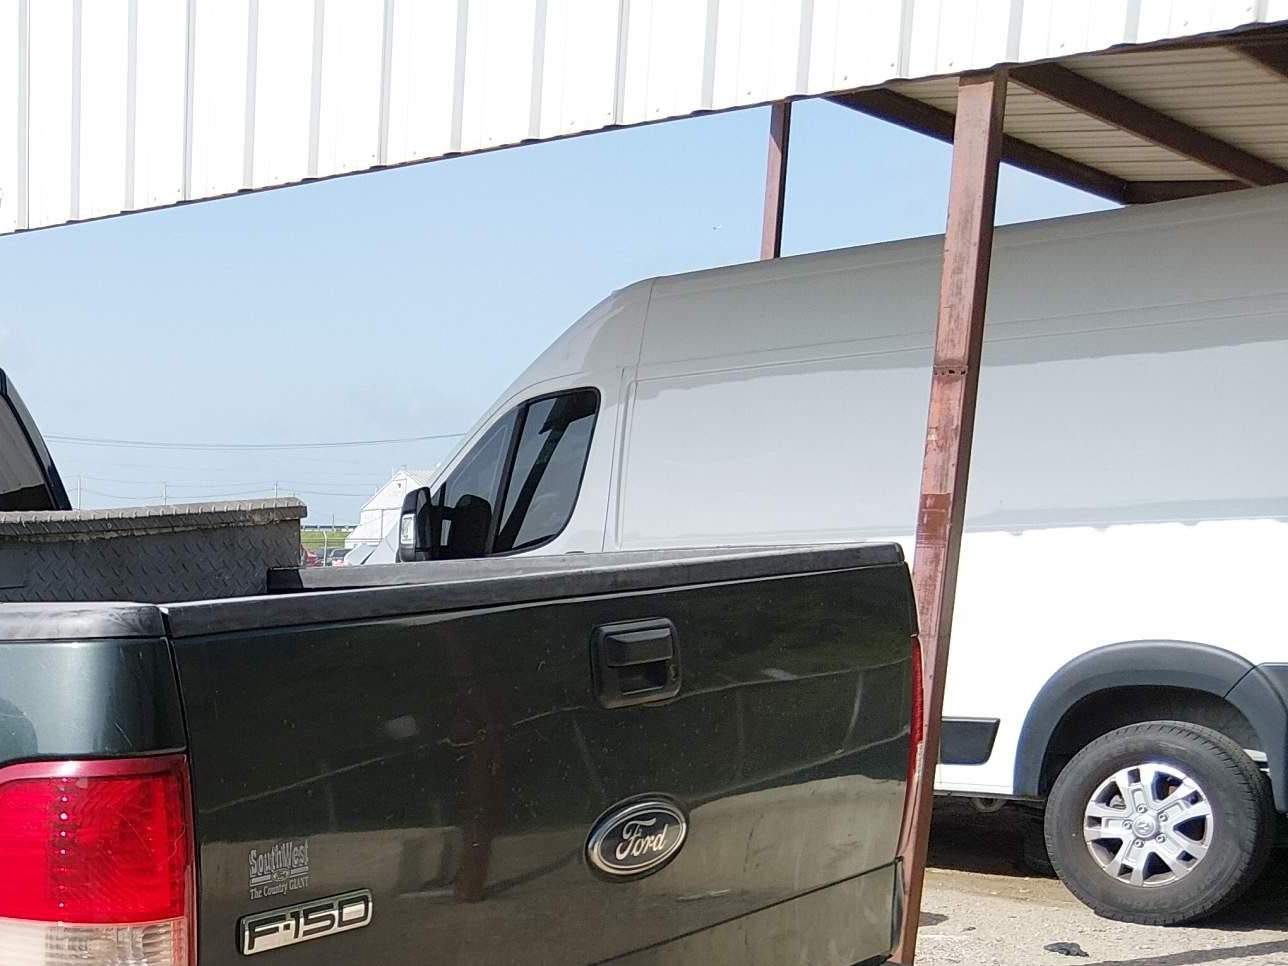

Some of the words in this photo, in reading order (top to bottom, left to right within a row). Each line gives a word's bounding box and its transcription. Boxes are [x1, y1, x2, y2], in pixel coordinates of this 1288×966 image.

[615, 817, 668, 860] Ford
[249, 887, 263, 900] The
[263, 881, 288, 897] Country
[248, 895, 369, 951] F-150
